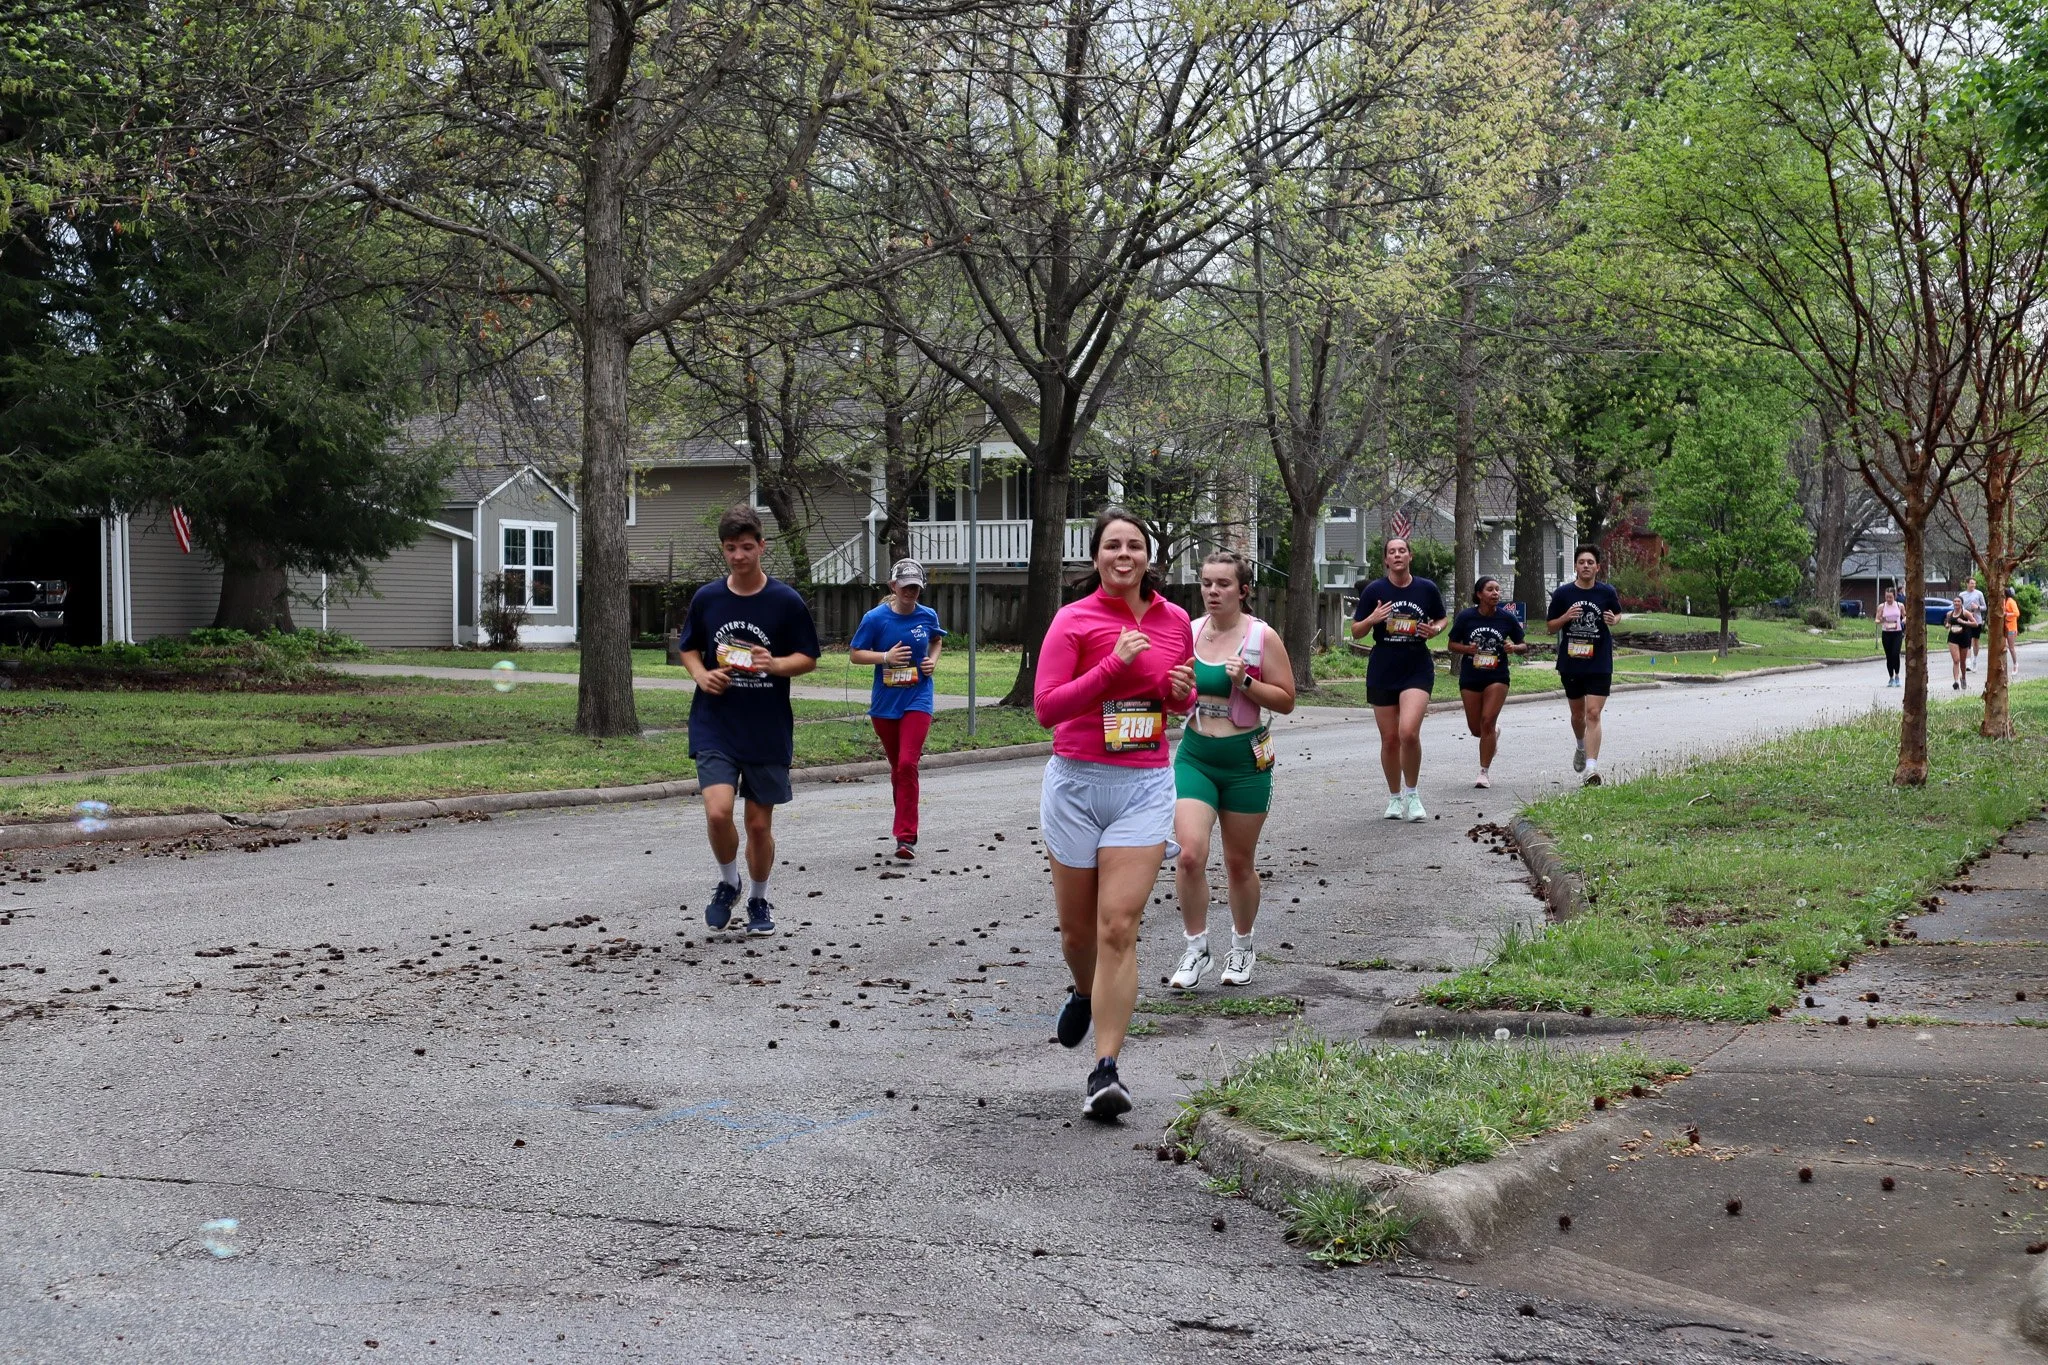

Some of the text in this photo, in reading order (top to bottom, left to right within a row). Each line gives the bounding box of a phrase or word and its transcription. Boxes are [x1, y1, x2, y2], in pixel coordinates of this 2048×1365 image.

[714, 621, 745, 643] POTTER'S
[747, 623, 770, 645] HOUSE
[1119, 716, 1154, 738] 2138
